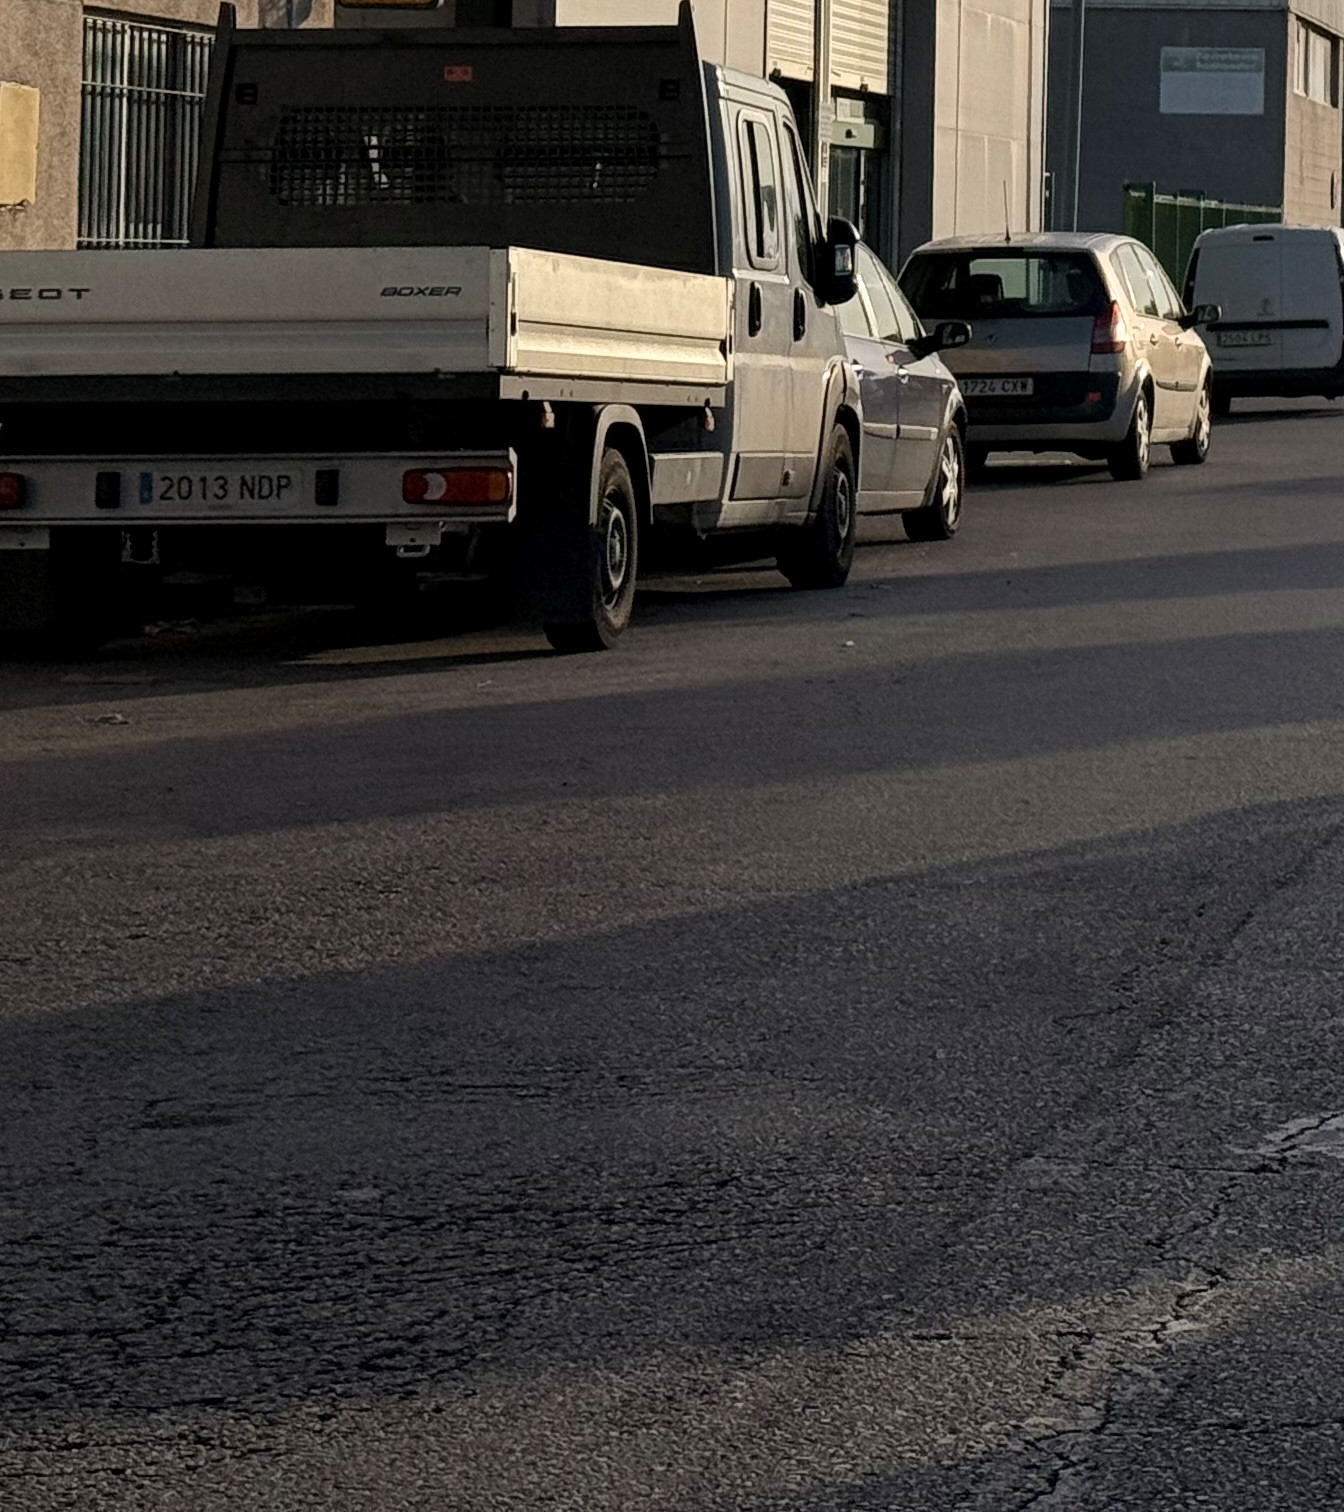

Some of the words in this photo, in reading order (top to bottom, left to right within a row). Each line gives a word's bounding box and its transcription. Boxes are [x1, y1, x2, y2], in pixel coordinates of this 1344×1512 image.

[380, 285, 462, 298] BOXER
[159, 475, 229, 501] 2013
[239, 474, 292, 500] NDP
